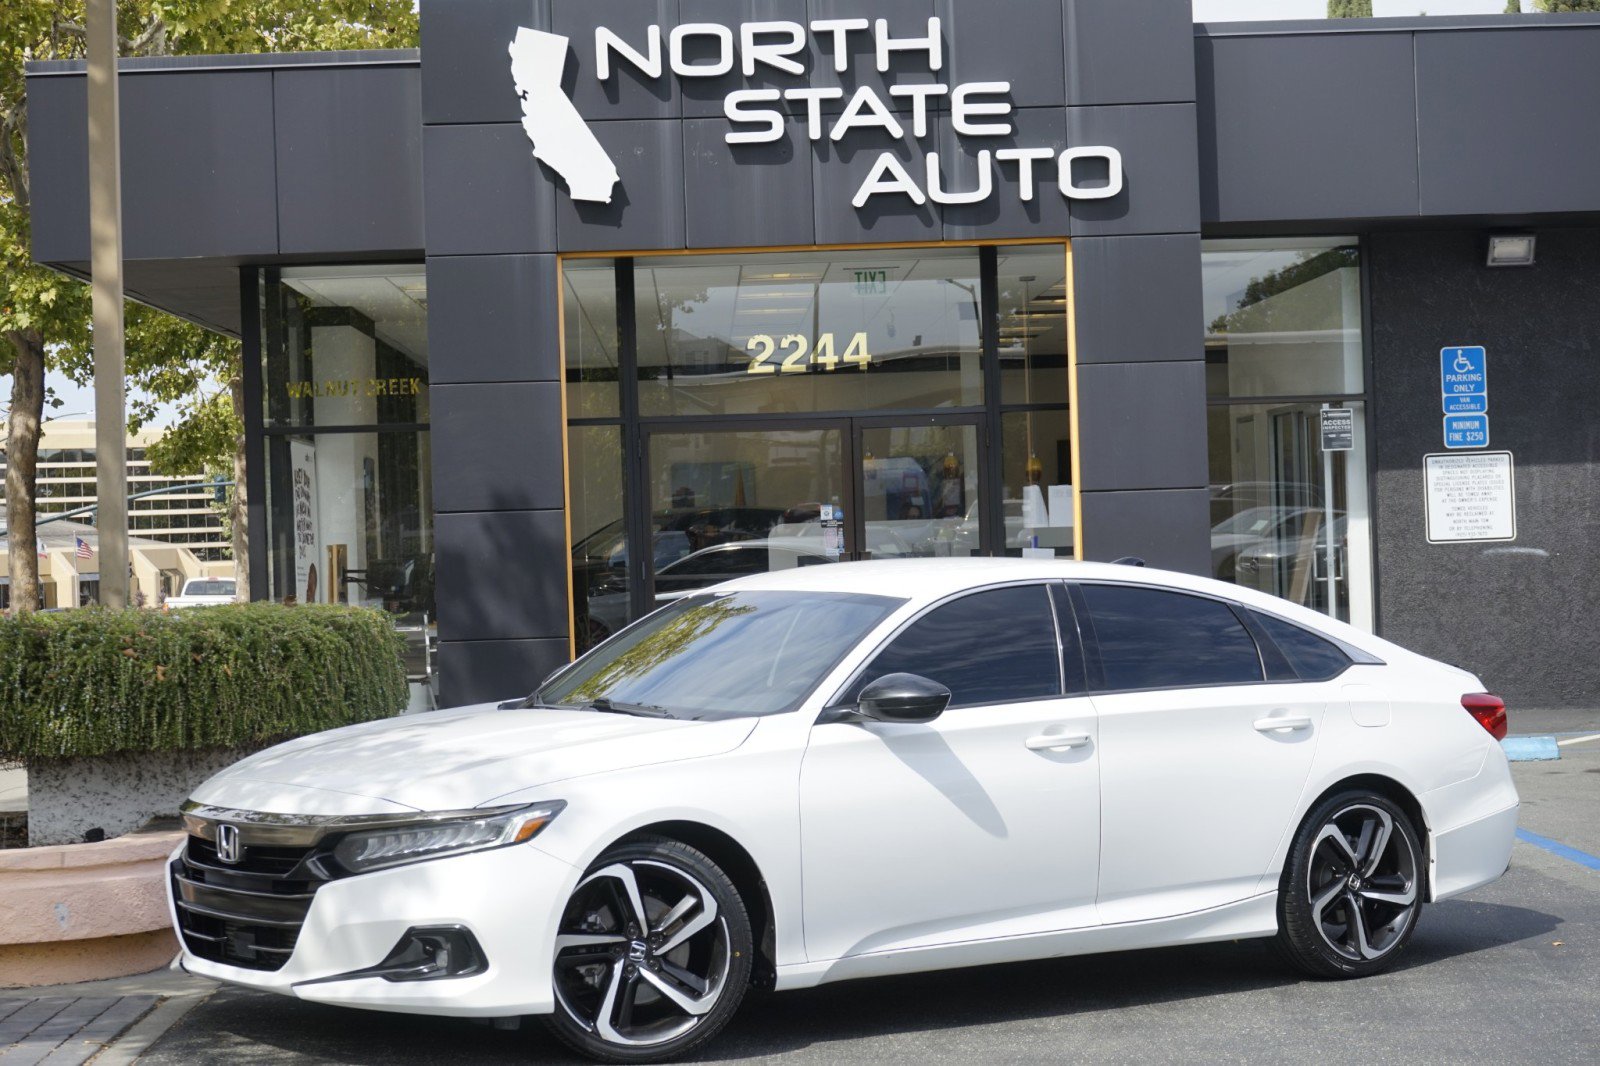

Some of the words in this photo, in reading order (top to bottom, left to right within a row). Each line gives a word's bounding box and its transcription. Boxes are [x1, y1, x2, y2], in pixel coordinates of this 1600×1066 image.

[595, 17, 942, 80] NORTH
[723, 81, 1012, 144] STATE
[851, 145, 1123, 208] AUTO
[746, 332, 872, 374] 2244
[1445, 373, 1482, 382] PARKING
[285, 379, 359, 399] WALNUT
[366, 377, 420, 398] CREEK
[1453, 384, 1475, 393] ONLY
[1449, 403, 1481, 411] ACCESSIBLE
[1452, 420, 1480, 430] MINIMUM
[1448, 432, 1464, 442] FINE
[1466, 431, 1484, 442] $250
